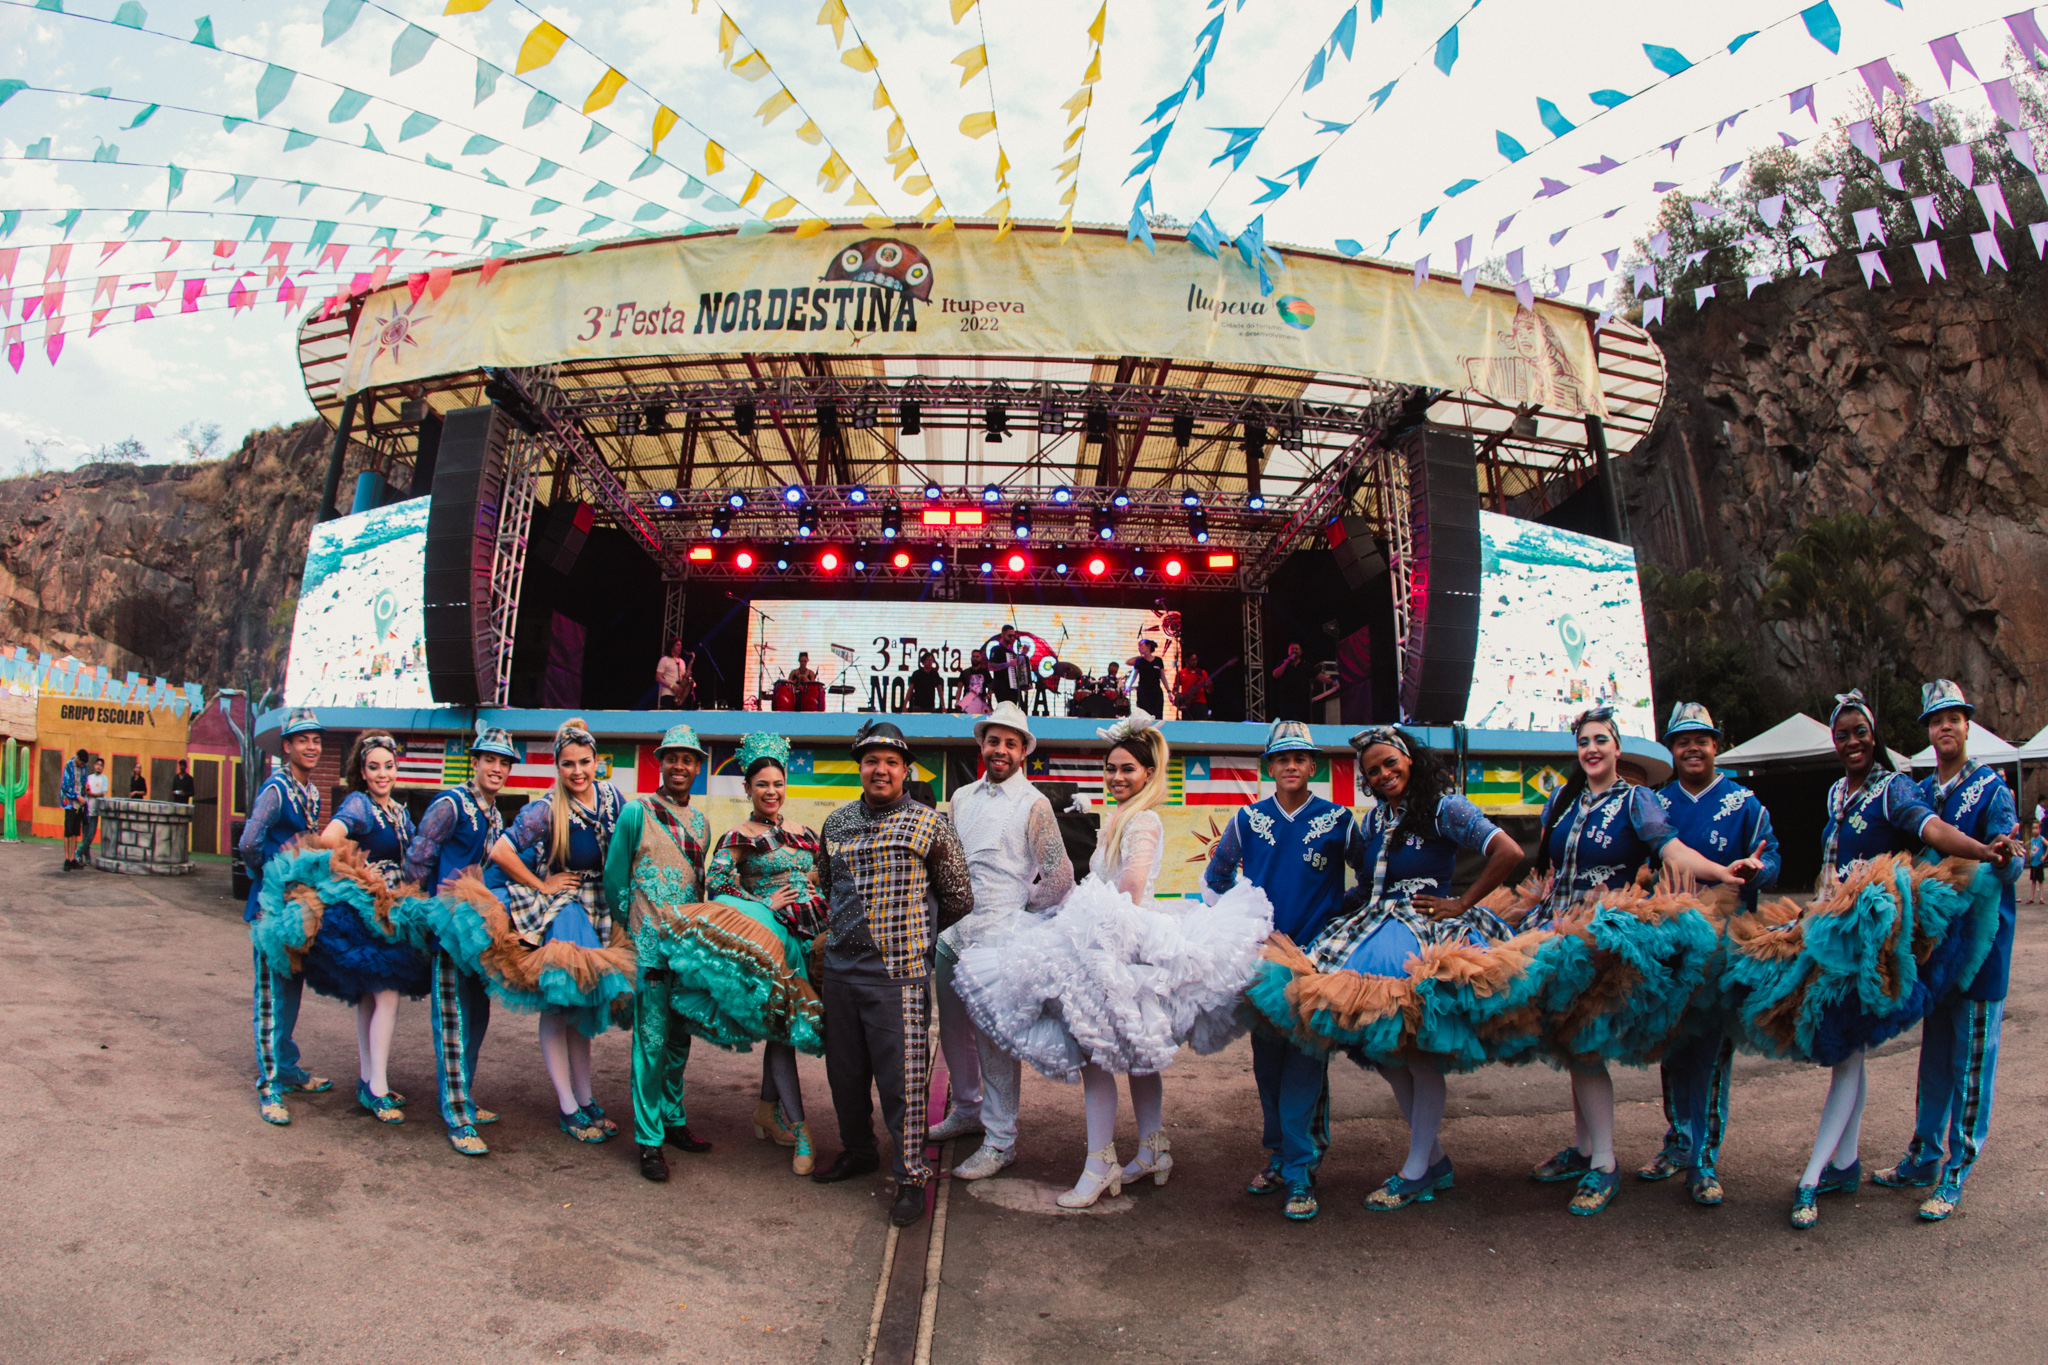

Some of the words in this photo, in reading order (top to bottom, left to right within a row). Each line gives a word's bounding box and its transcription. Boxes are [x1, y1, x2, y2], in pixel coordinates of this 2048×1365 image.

[610, 300, 685, 338] Festa
[693, 286, 918, 335] NORDESTINA
[941, 297, 1025, 315] Itupeva
[1187, 283, 1269, 323] Itupeva
[960, 316, 999, 332] 2022
[1221, 321, 1245, 329] Cidade
[60, 704, 96, 722] GRUPO
[96, 707, 145, 726] ESCOLAR
[1848, 811, 1868, 834] JSP
[1587, 825, 1613, 849] JSP
[1302, 847, 1328, 871] JSP
